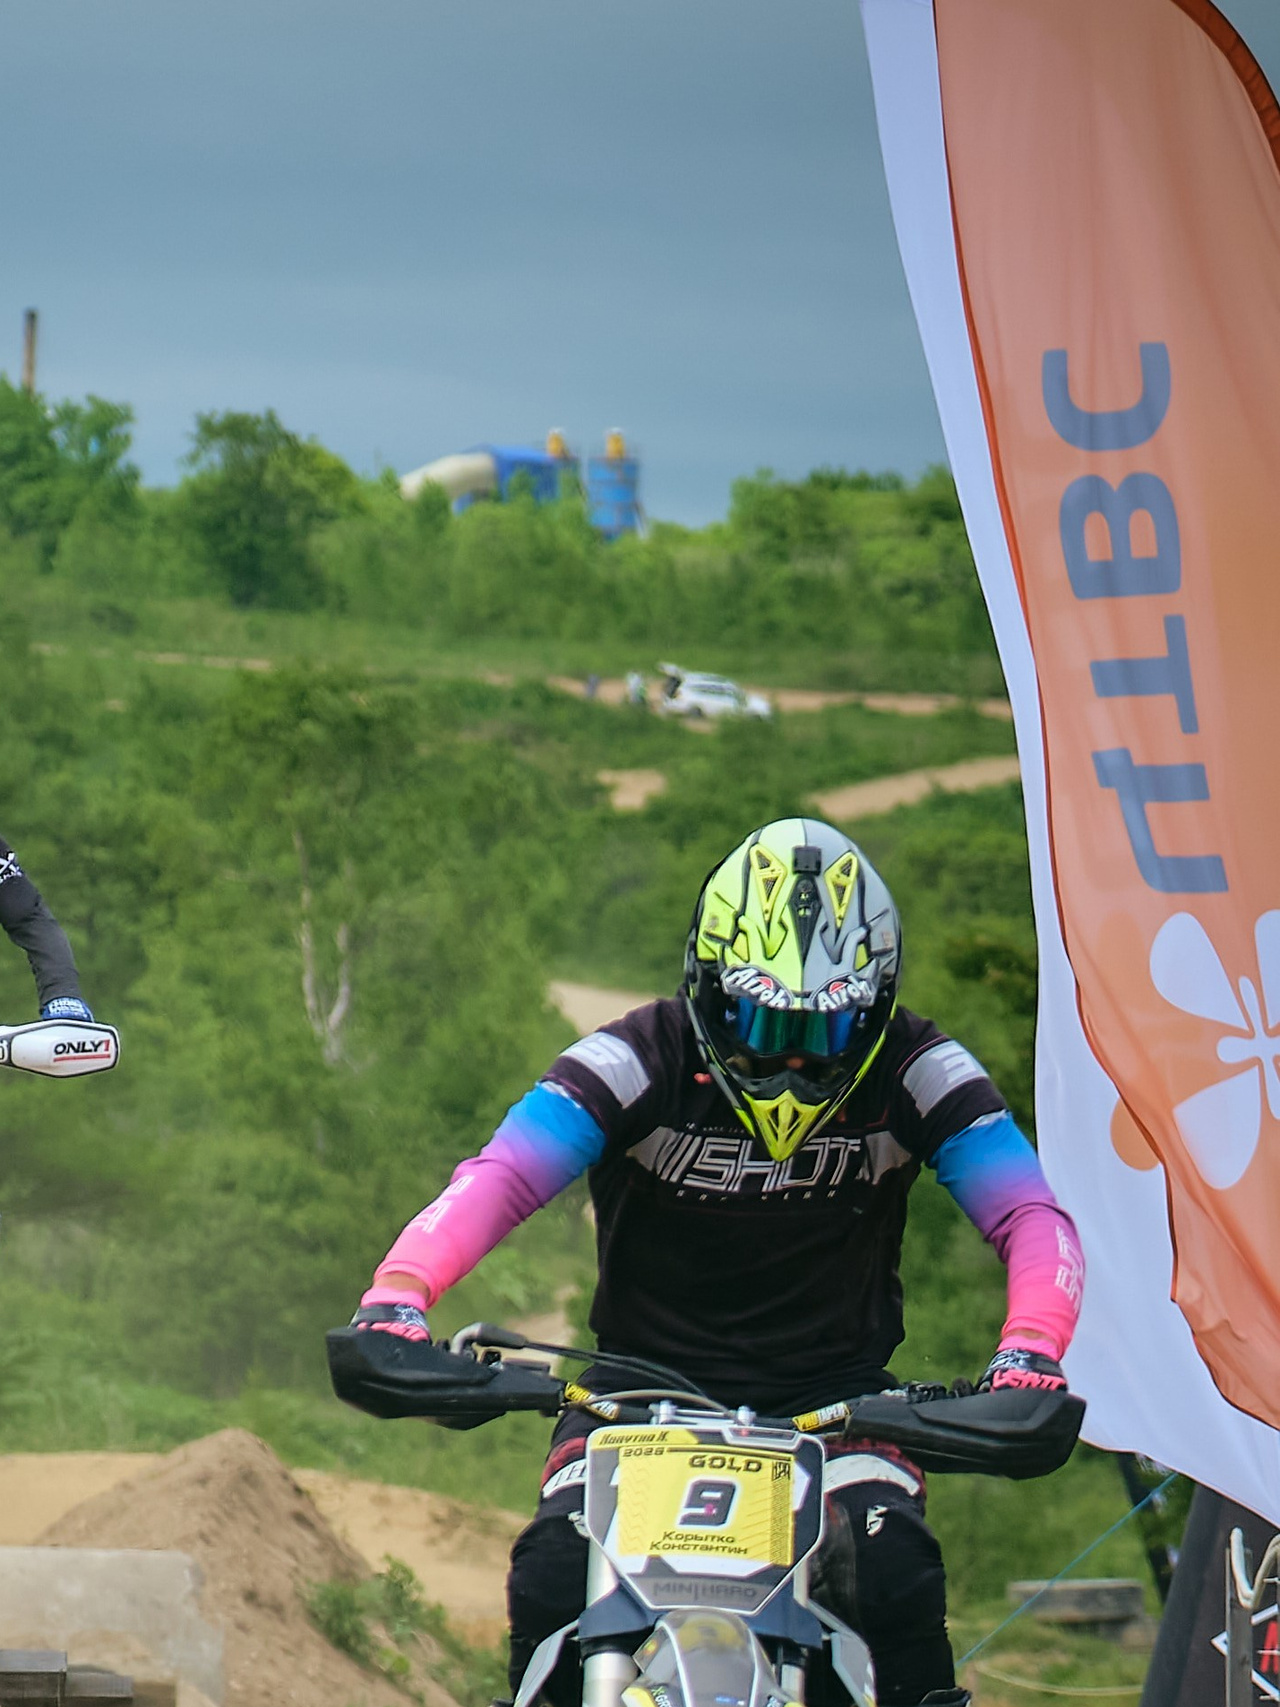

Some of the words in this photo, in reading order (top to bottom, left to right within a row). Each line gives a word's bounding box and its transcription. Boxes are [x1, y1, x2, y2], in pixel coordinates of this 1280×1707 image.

[54, 1040, 110, 1055] ONLY1
[689, 1455, 762, 1473] GOLD
[678, 1479, 737, 1526] 9
[650, 1541, 748, 1555] Константин
